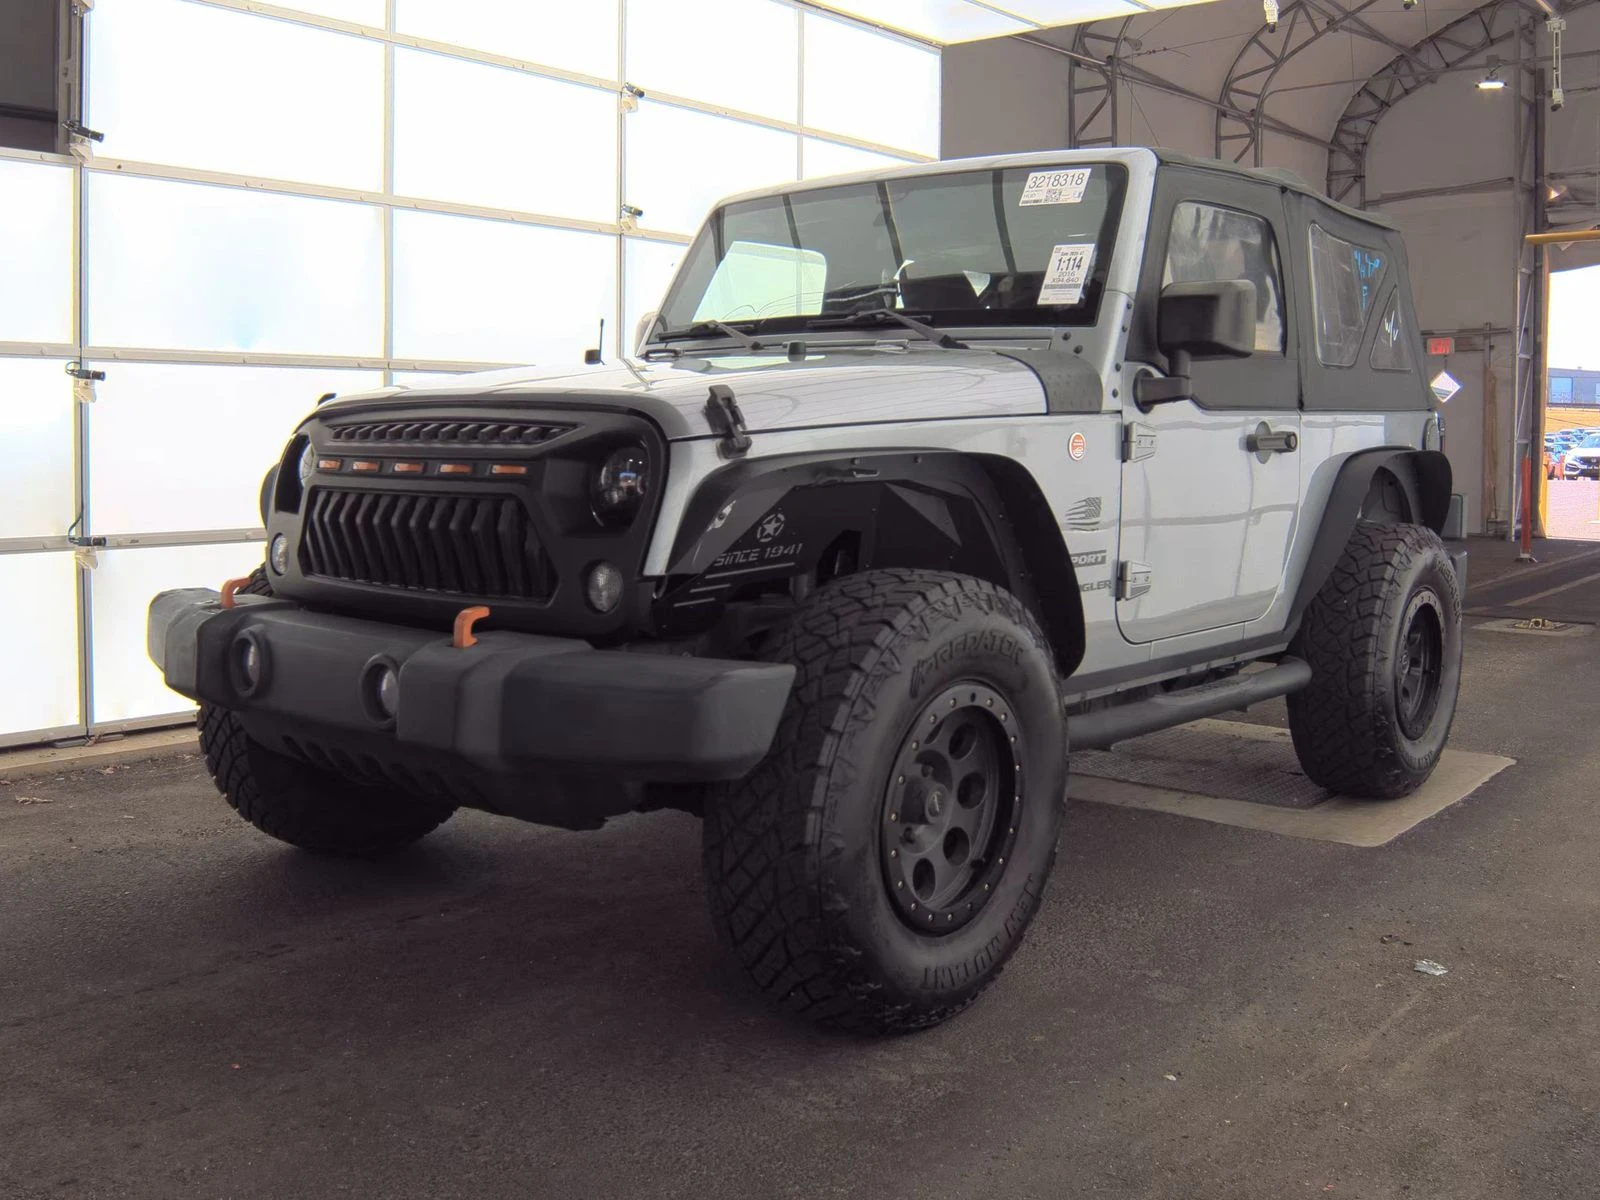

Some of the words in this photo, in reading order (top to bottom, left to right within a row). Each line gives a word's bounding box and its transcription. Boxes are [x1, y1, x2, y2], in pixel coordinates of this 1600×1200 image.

[1028, 172, 1085, 189] 3218318
[1056, 256, 1083, 271] 1:114
[713, 548, 761, 567] SINCE
[764, 543, 803, 559] 1941
[1070, 553, 1107, 565] PORT
[1079, 579, 1112, 592] GLER
